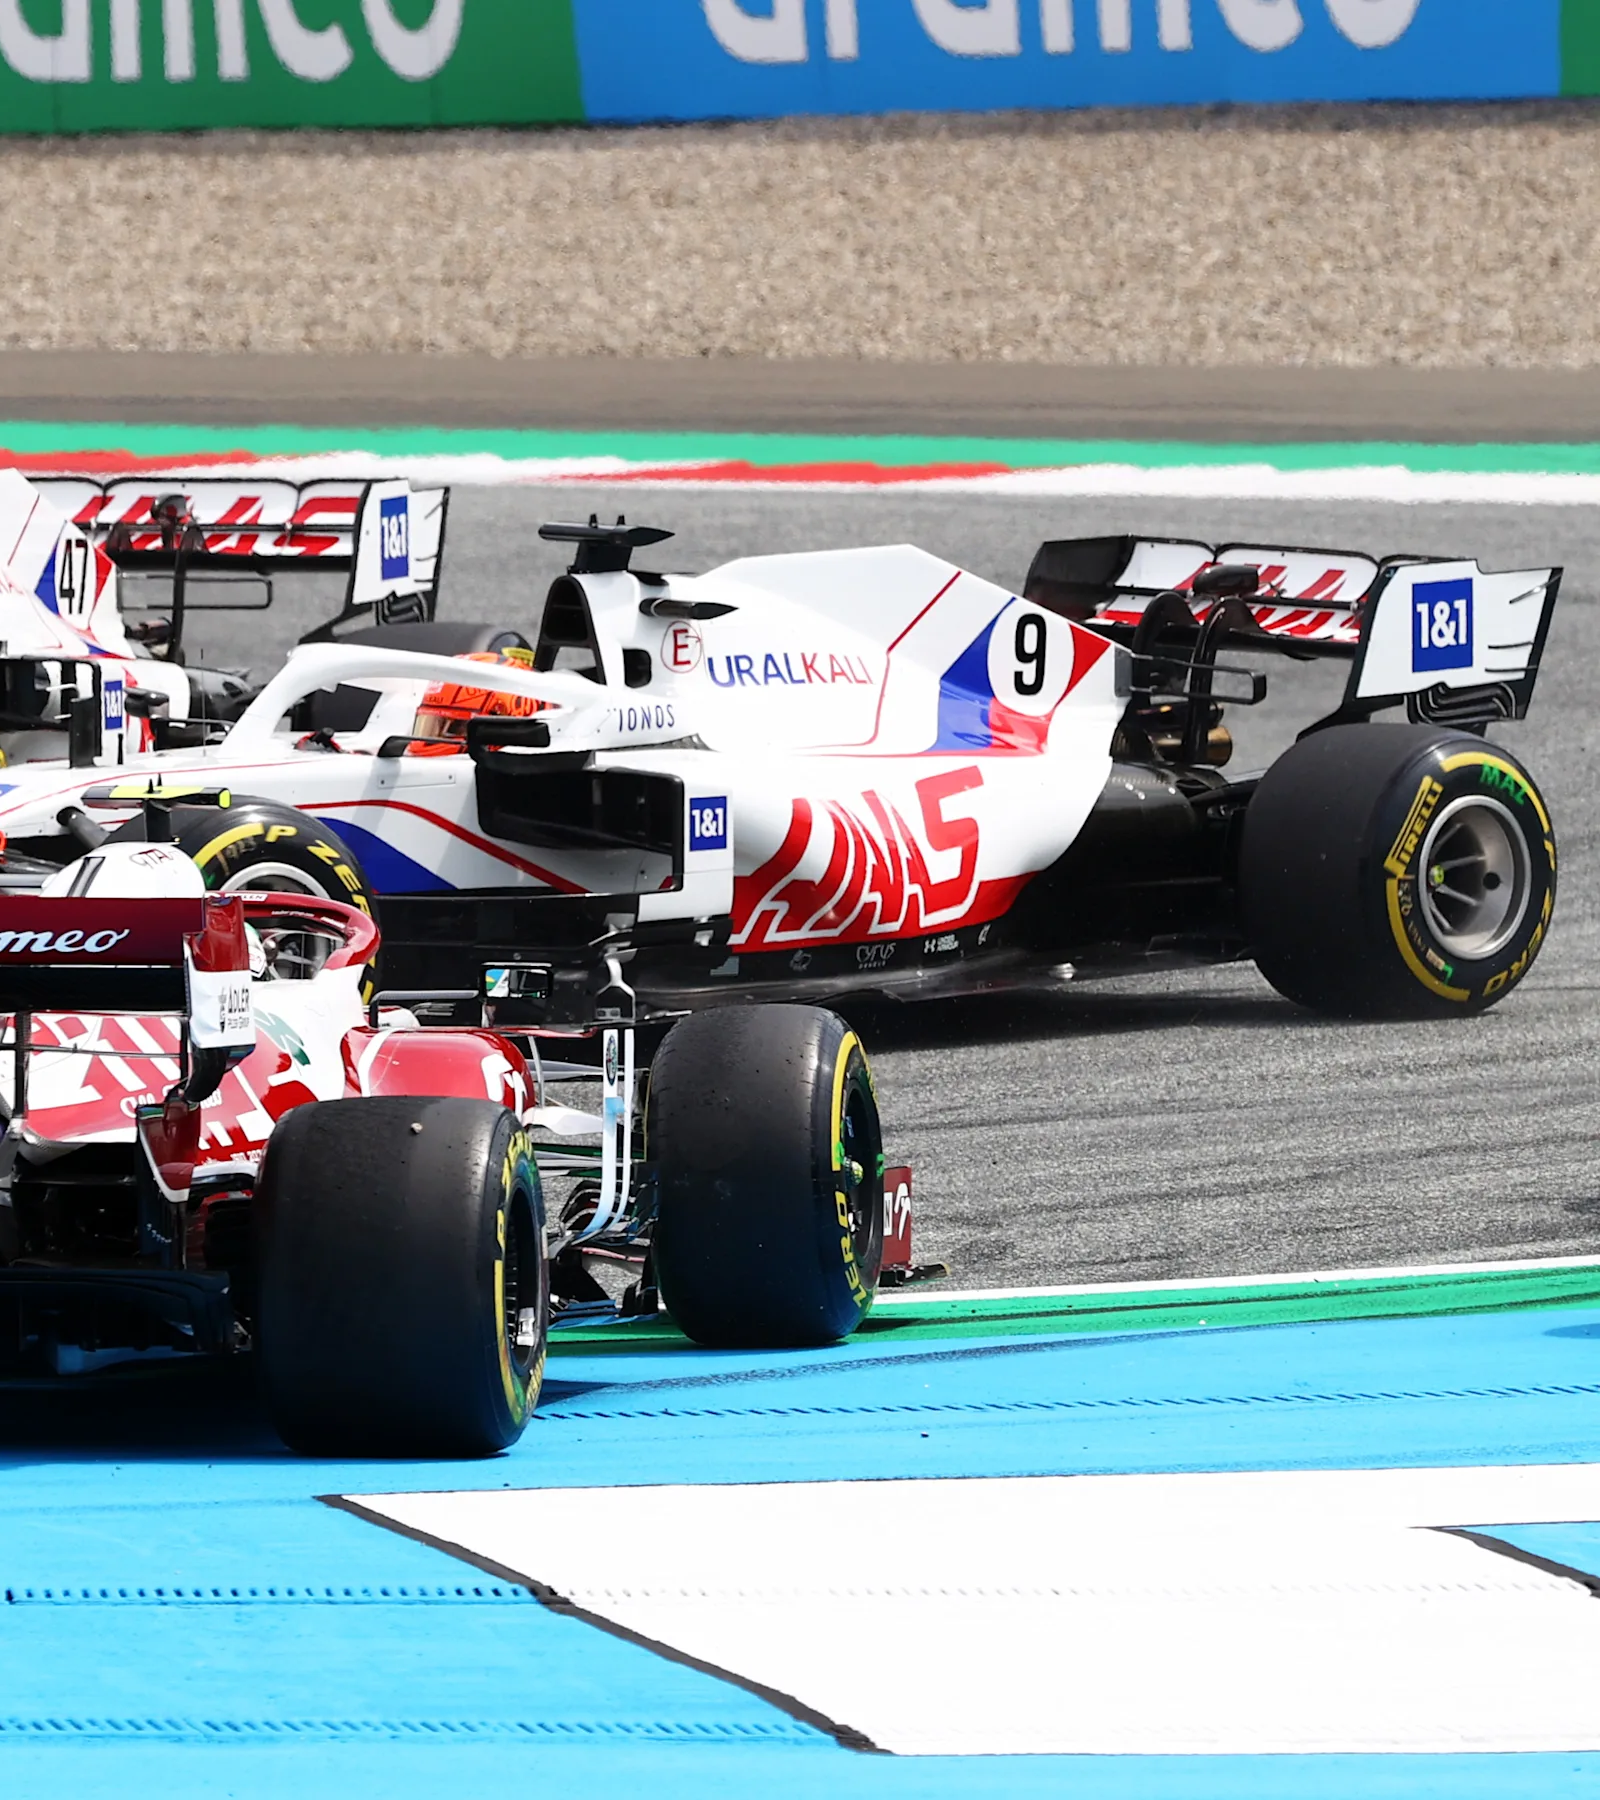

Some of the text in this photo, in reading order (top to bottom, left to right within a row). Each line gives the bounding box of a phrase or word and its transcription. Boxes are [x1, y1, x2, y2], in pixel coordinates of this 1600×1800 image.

[381, 513, 409, 561] 1&1
[59, 538, 89, 615] 47
[1416, 599, 1467, 648] 1&1
[706, 651, 874, 688] URALKALI
[1013, 612, 1047, 696] 9
[618, 703, 675, 732] IONOS
[691, 807, 725, 838] 1&1
[1384, 774, 1445, 876] PIRELLI
[264, 824, 298, 843] P
[306, 838, 373, 921] ZER
